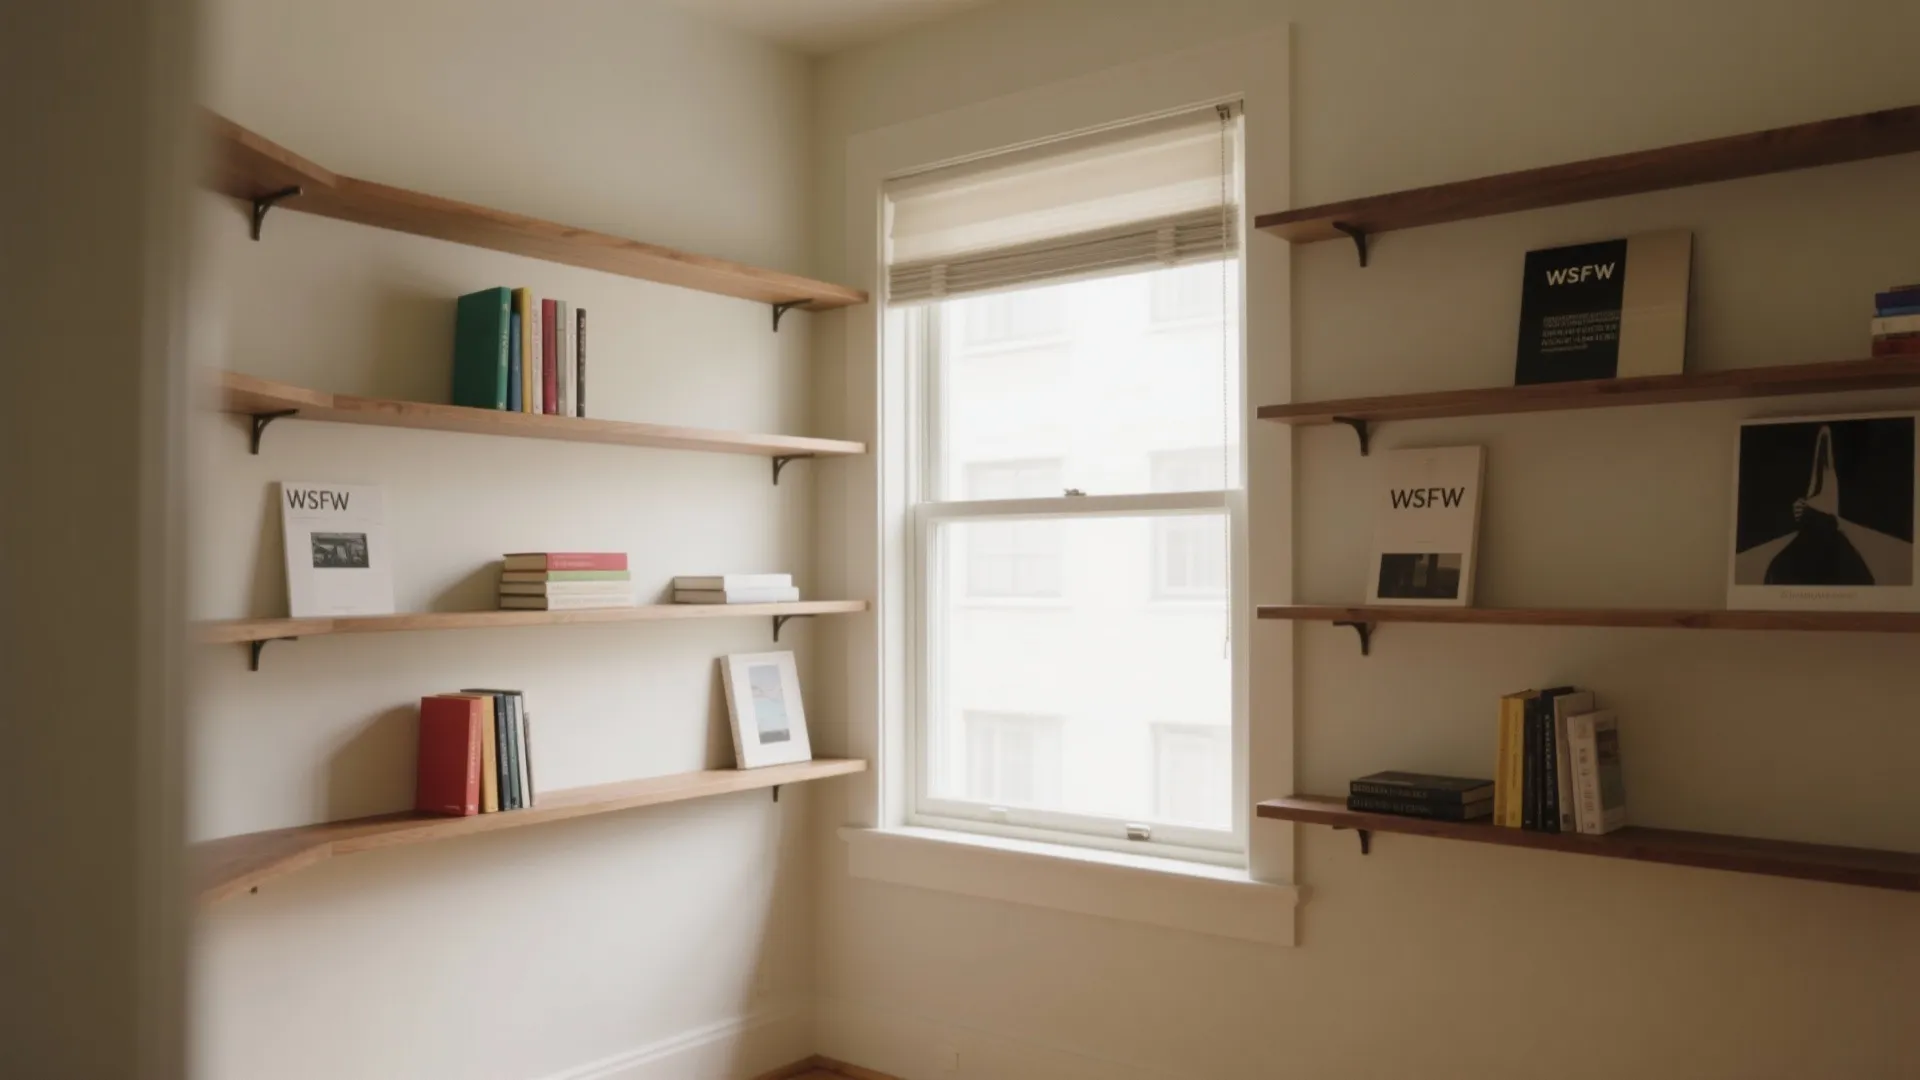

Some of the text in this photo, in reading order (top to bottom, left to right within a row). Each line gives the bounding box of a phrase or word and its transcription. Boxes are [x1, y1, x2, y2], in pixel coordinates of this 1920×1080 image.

[1546, 262, 1615, 286] WSFW
[286, 488, 350, 511] WSFW
[1390, 487, 1465, 509] WSFW
